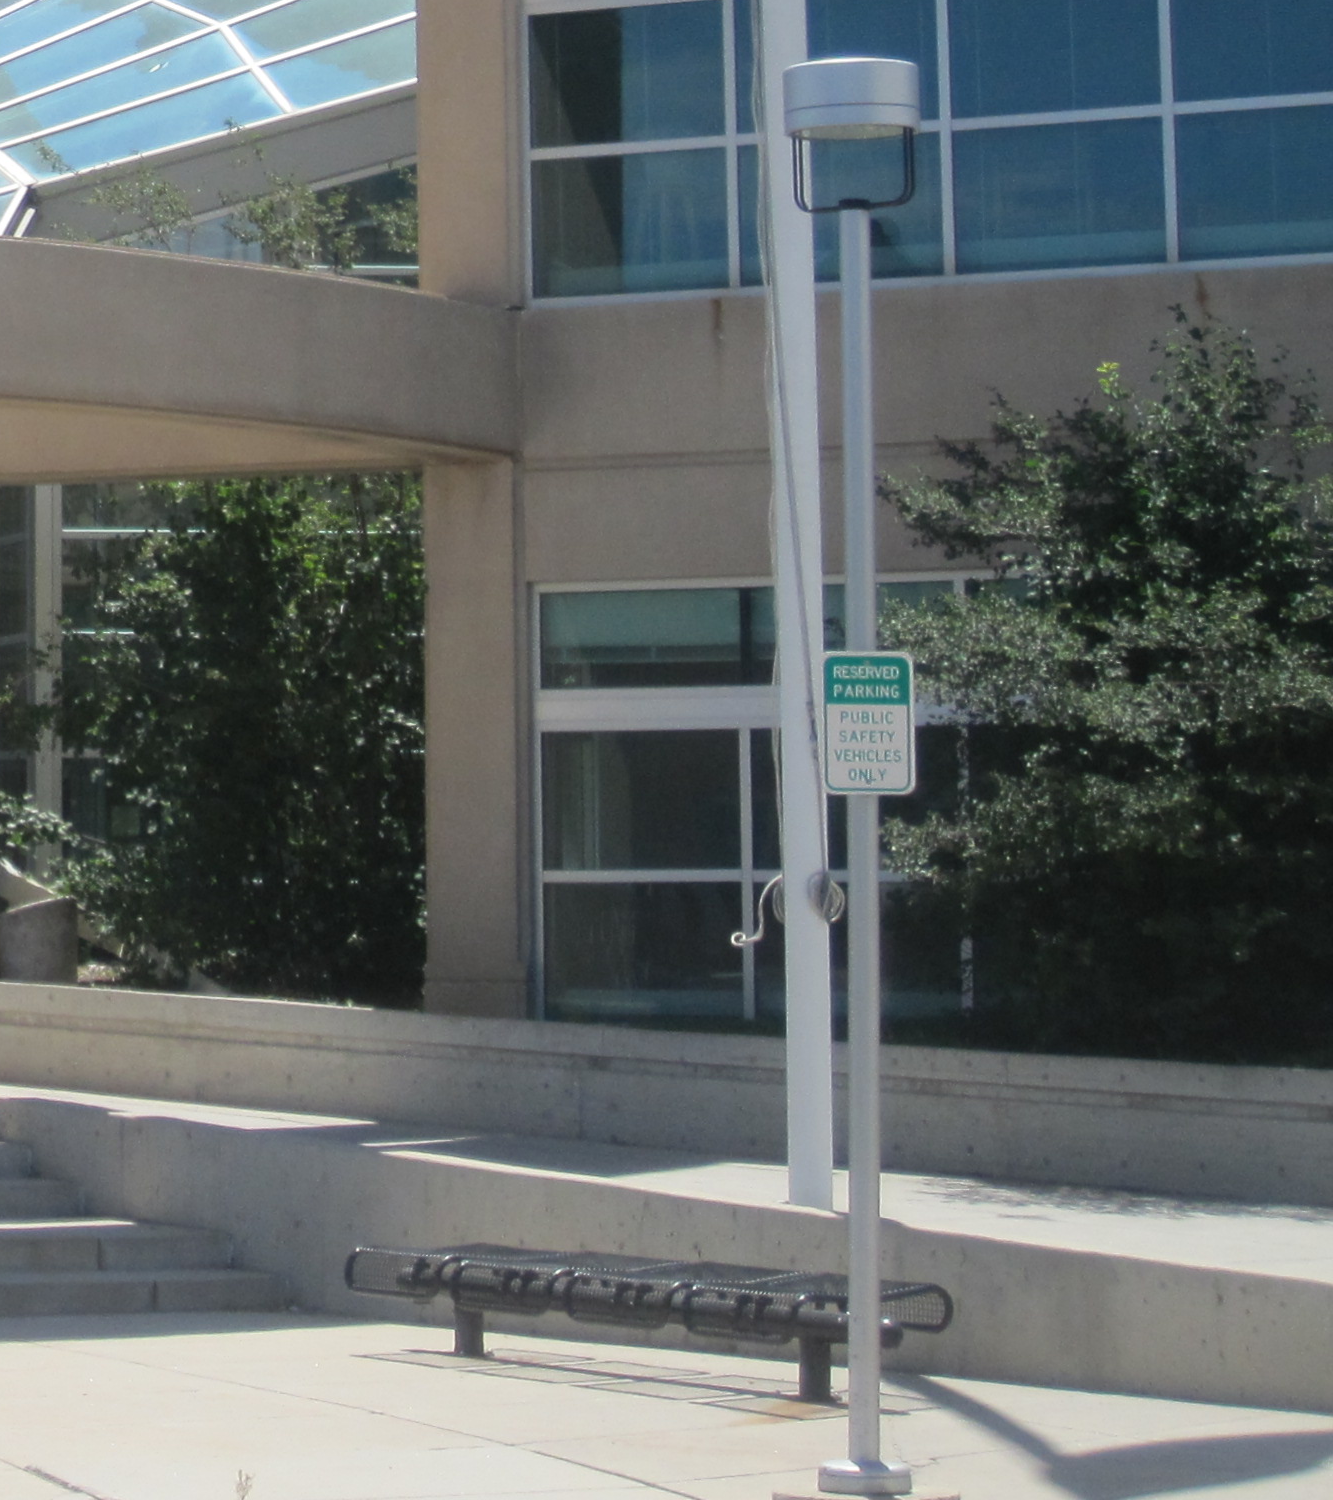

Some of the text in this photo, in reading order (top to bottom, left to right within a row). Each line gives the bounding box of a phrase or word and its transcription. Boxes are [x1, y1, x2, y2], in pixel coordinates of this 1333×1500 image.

[833, 666, 900, 680] RESERVED
[833, 684, 900, 699] PARKING
[840, 711, 894, 725] PUBLIC
[839, 730, 896, 744] SAFETY
[834, 749, 902, 763] VEHICLES
[848, 768, 887, 782] ONLY
